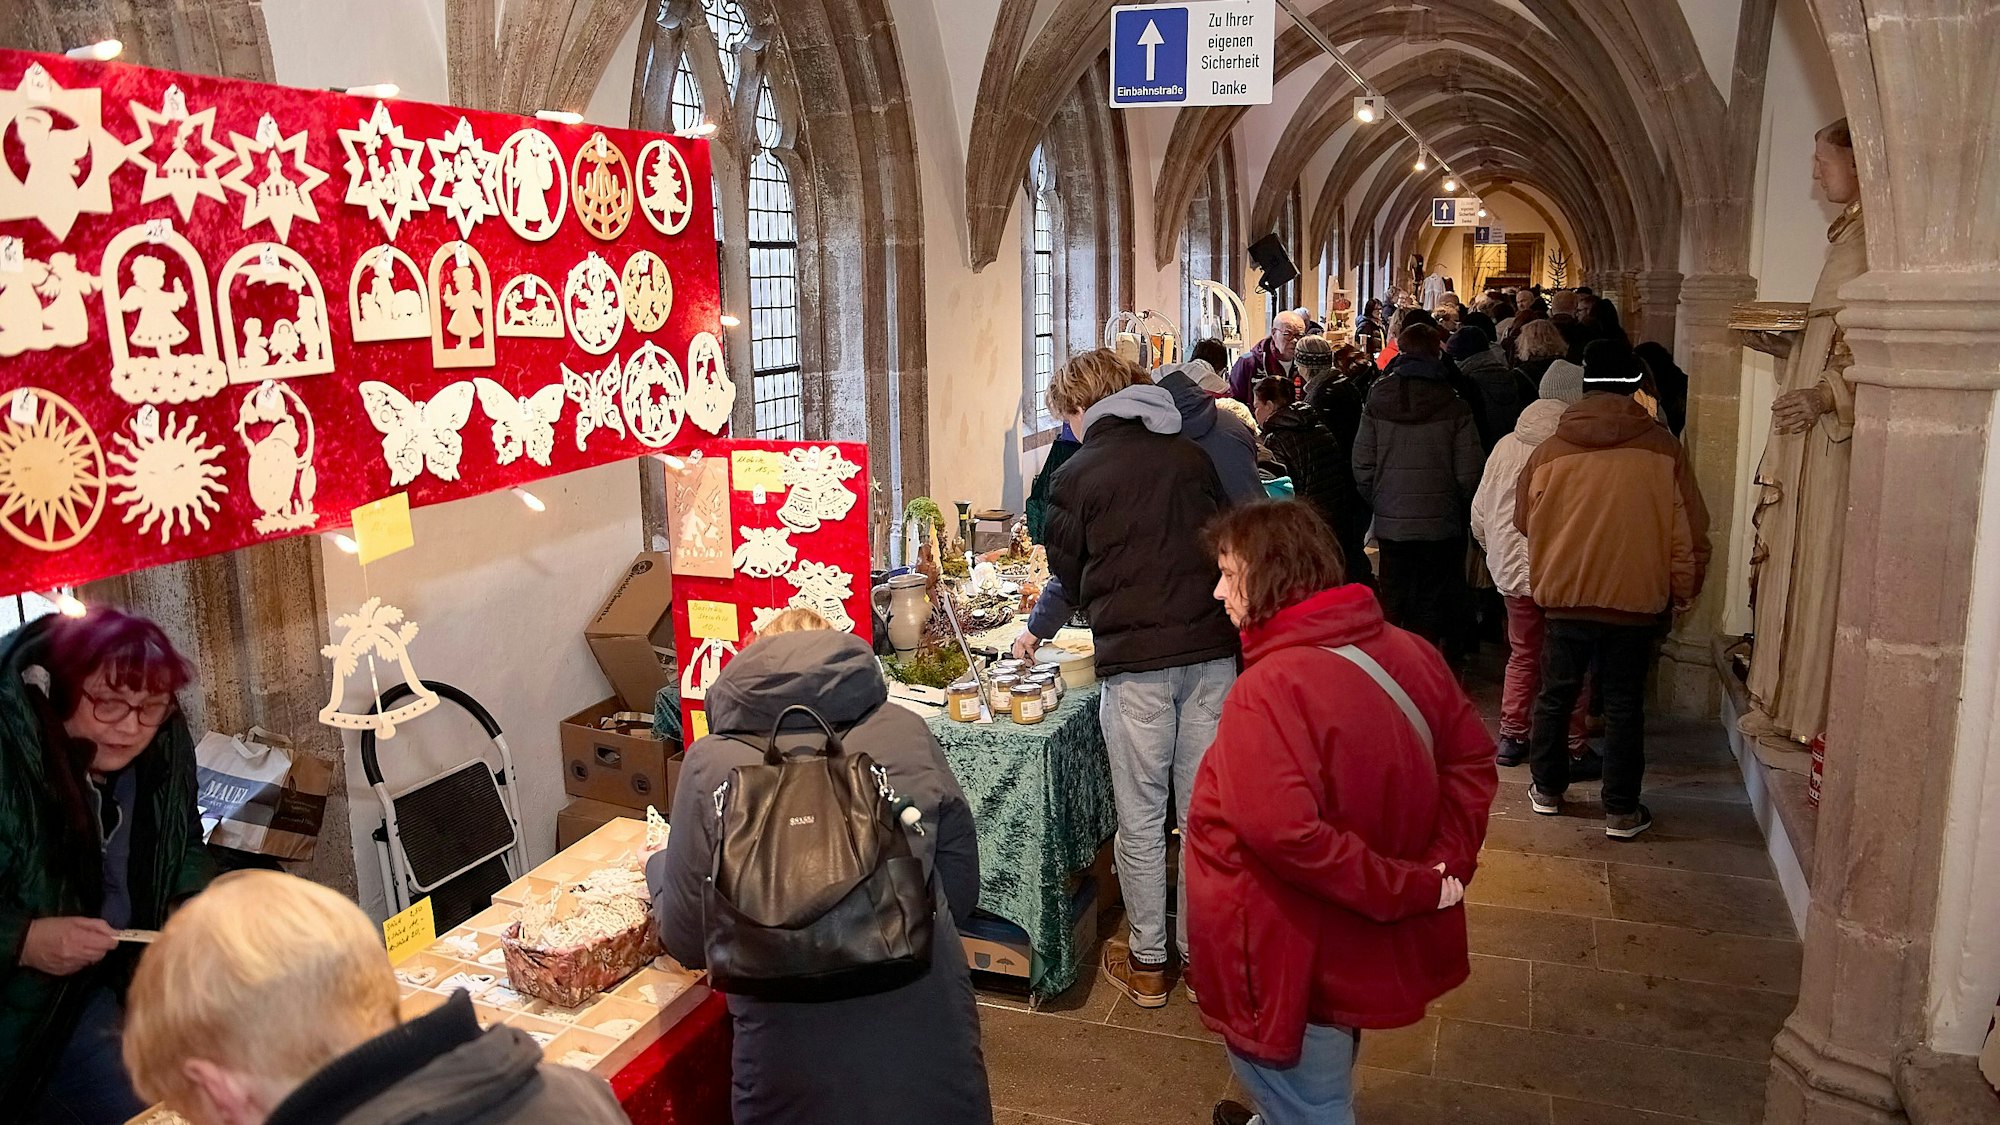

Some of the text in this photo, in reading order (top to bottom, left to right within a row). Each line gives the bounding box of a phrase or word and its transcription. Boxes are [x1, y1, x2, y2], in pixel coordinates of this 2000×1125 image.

[1208, 12, 1255, 28] Zu Ihrer
[1208, 35, 1253, 52] eigenen
[1201, 54, 1260, 70] Sicherheit
[1117, 85, 1184, 97] Einbahnstraße
[1212, 80, 1247, 95] Danke
